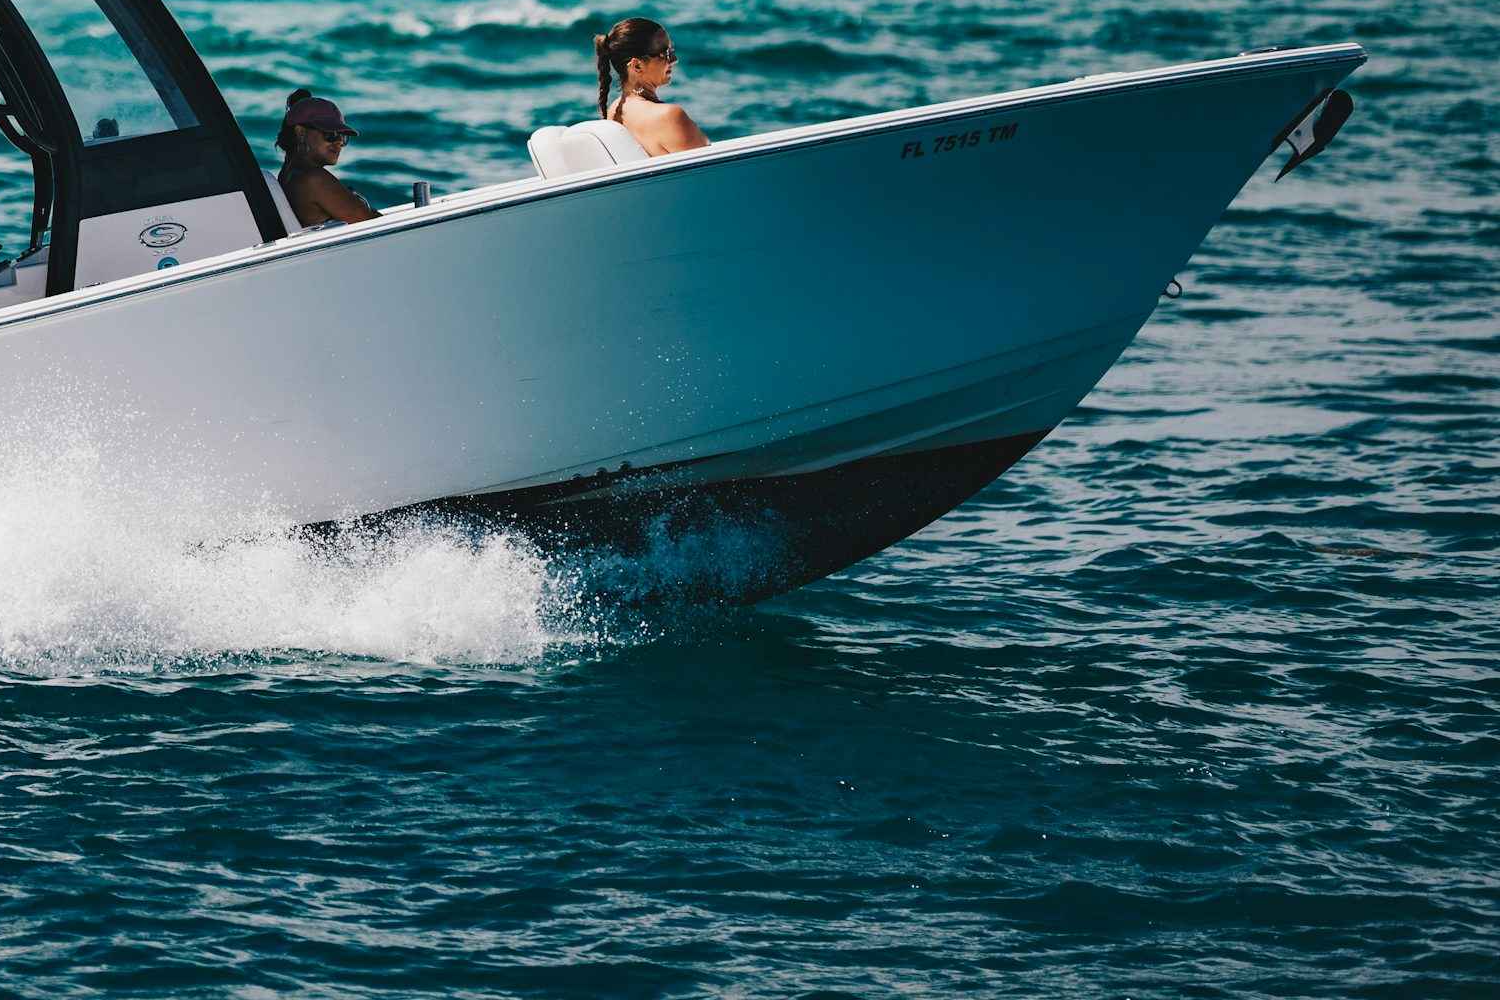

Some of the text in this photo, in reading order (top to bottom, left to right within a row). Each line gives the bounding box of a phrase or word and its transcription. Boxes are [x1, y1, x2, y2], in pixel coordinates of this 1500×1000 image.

[901, 122, 1018, 159] FL 7515 TM
